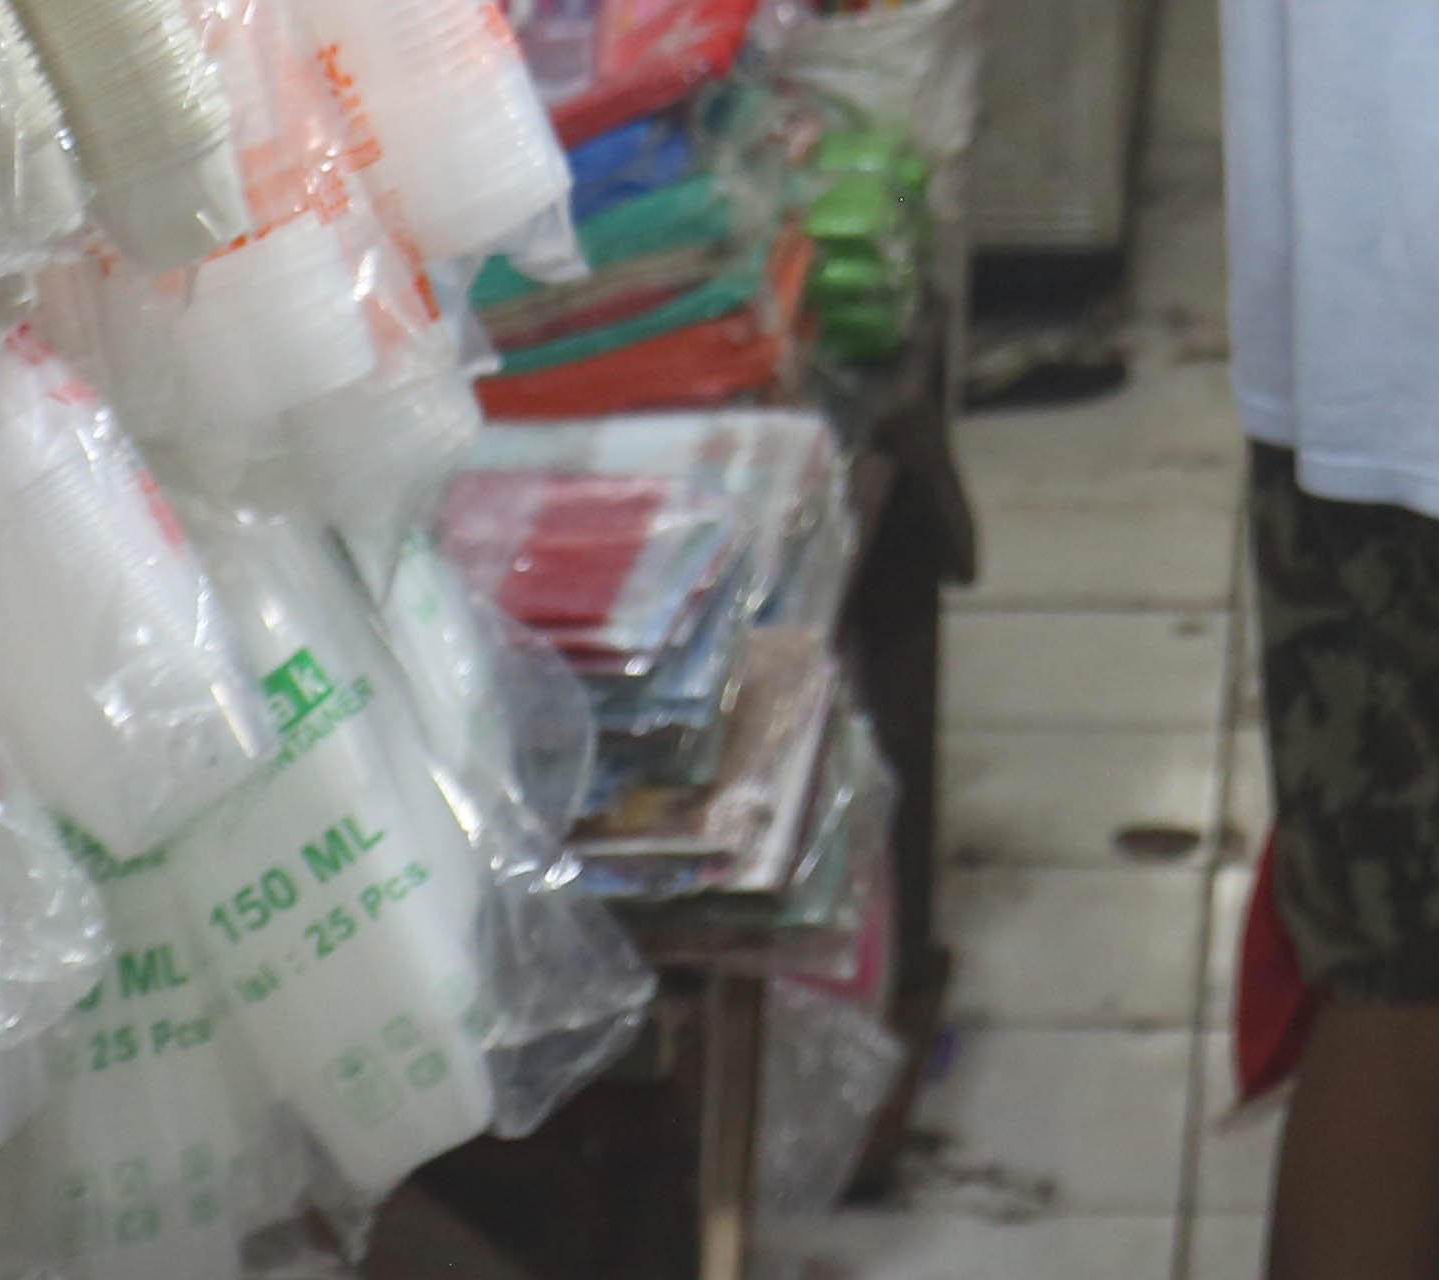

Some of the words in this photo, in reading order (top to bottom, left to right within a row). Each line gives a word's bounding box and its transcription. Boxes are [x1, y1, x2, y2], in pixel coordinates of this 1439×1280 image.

[210, 868, 299, 945] 150
[301, 817, 387, 884] ML
[304, 905, 358, 958] 25
[360, 860, 430, 922] Pcs
